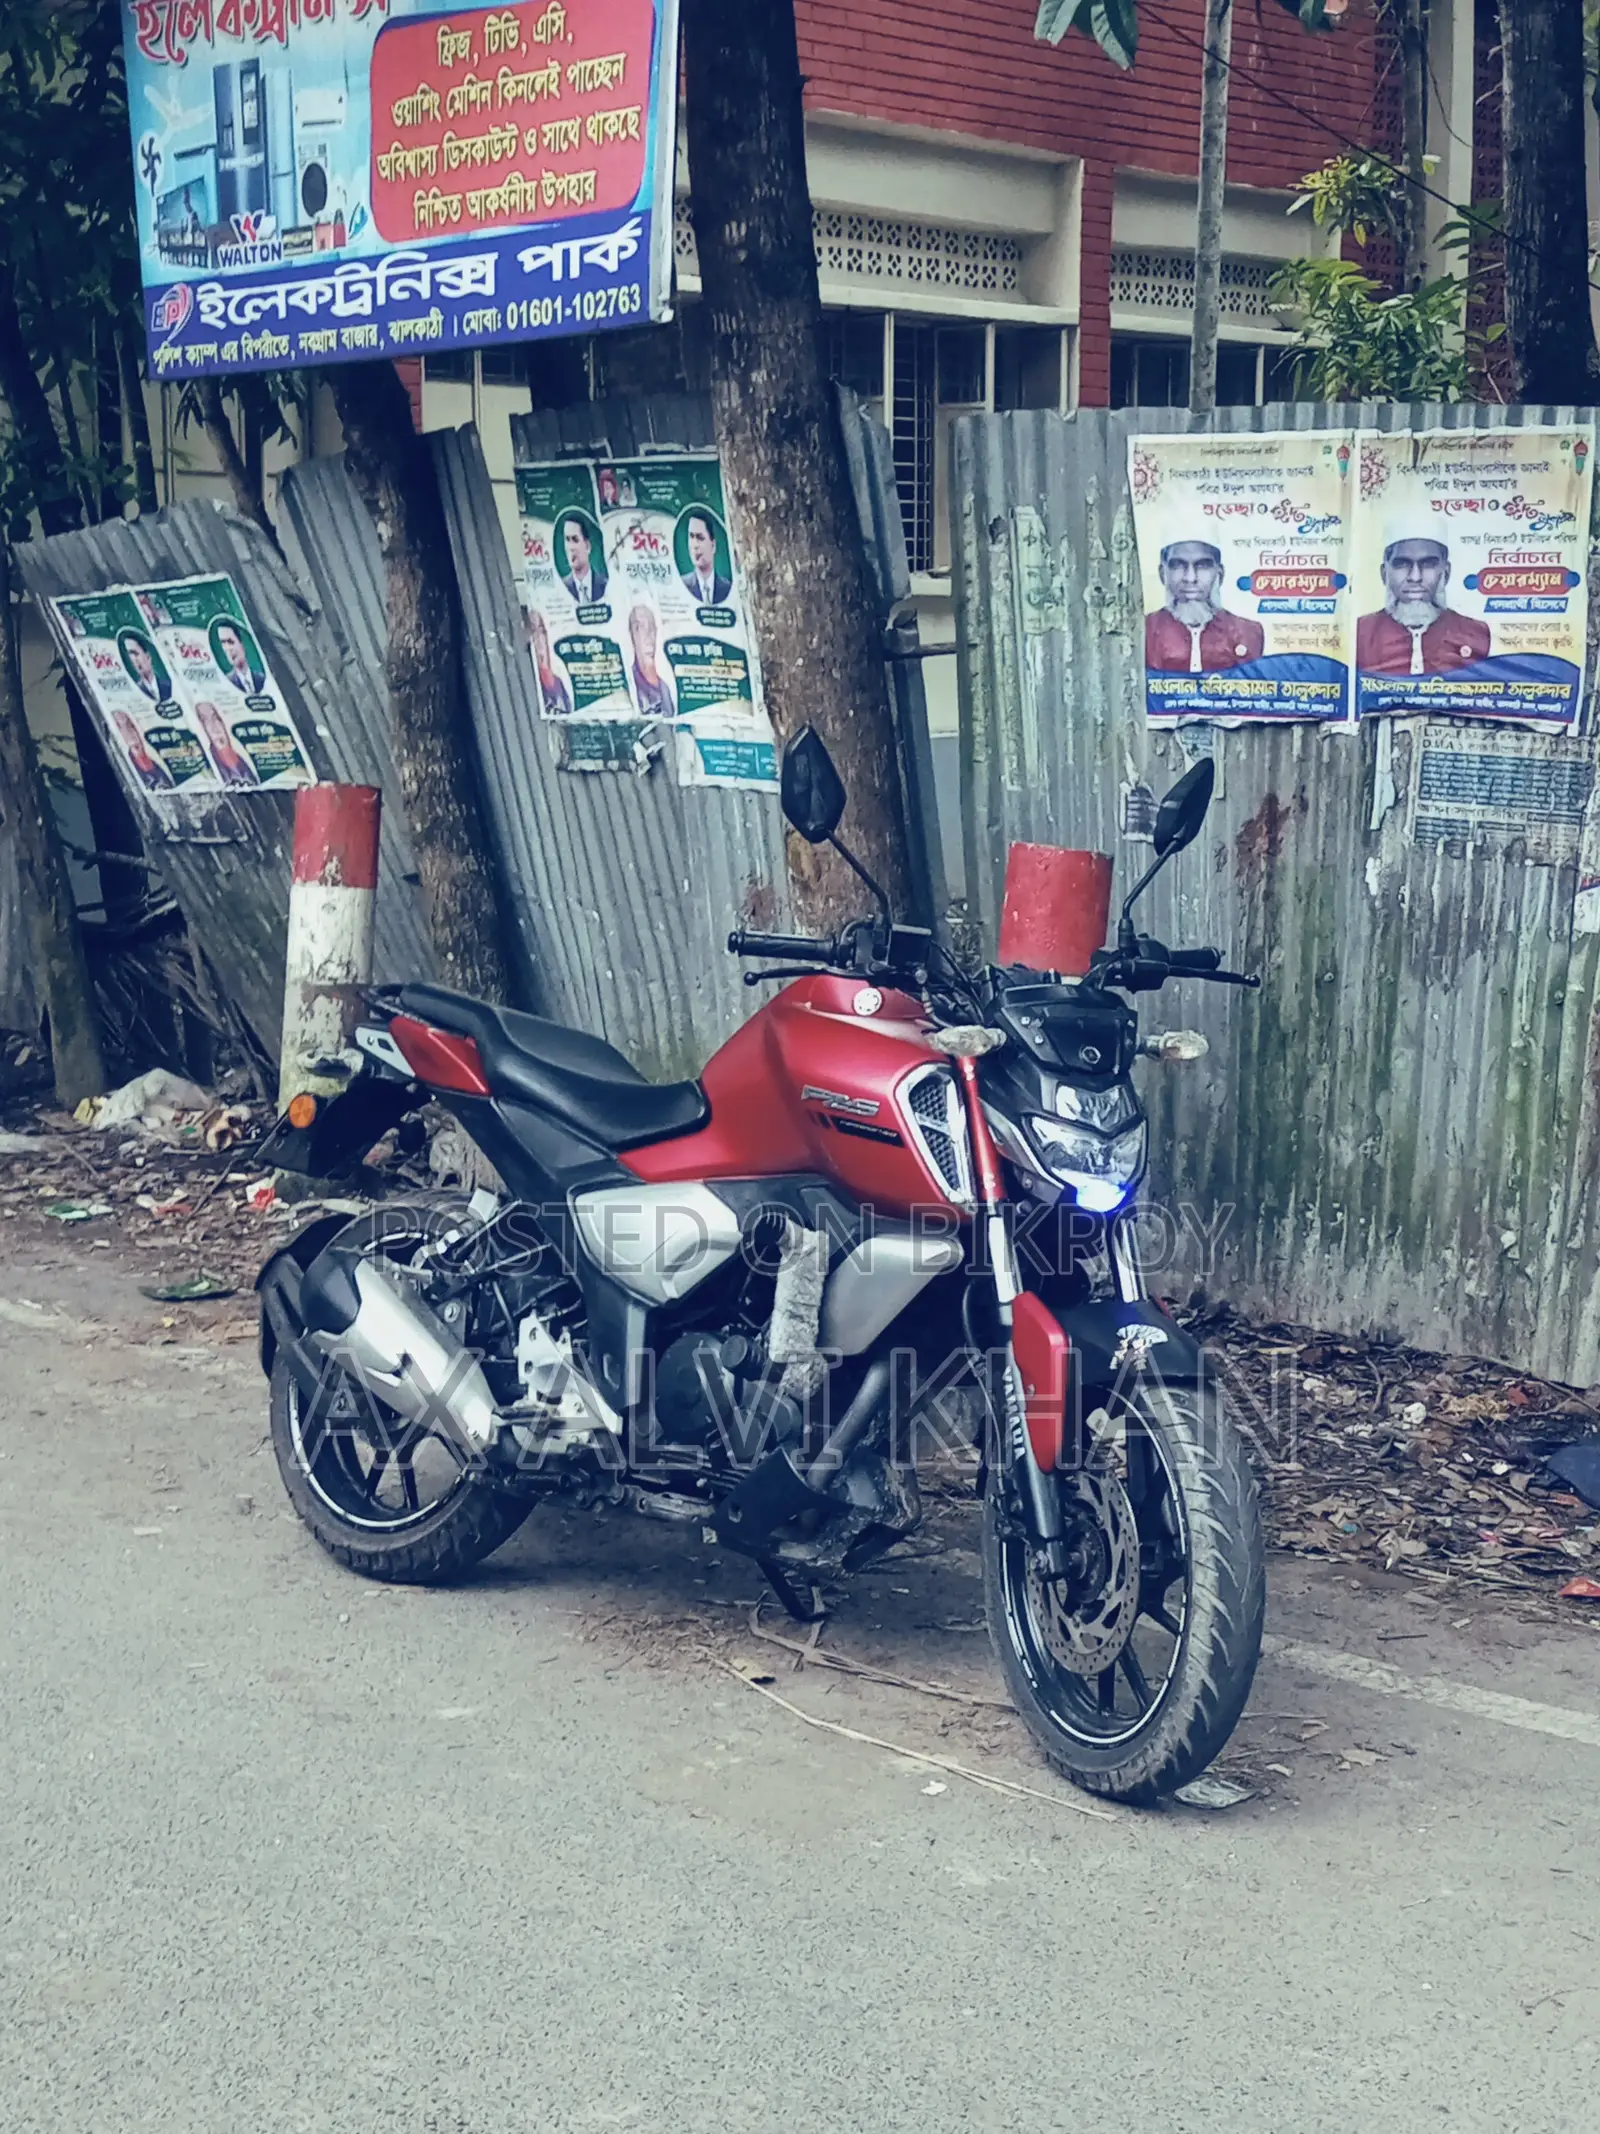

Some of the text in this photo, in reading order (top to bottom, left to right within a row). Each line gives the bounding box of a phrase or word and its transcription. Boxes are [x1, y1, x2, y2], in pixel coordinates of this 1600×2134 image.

[446, 73, 493, 118] মেশিন
[497, 61, 561, 109] কিনলেই
[566, 52, 627, 94] পাচ্ছেন
[443, 123, 519, 173] ডিসকাউন্ট
[523, 129, 538, 156] ও
[542, 117, 582, 153] সাথে
[586, 105, 641, 146] থাকছে
[414, 187, 463, 230] নিশ্চিত
[540, 169, 597, 207] উপহার
[196, 217, 642, 329] ইলেকট্রনিক্স পার্ক
[220, 241, 283, 268] WALTON
[221, 340, 240, 363] এর
[506, 283, 642, 331] 01601-102763
[1259, 549, 1328, 566] নির্বাচনে
[1488, 547, 1562, 565] নির্বাচনে
[1148, 679, 1197, 695] মাওলানা
[1281, 682, 1342, 702] তালুকদার
[1360, 676, 1417, 694] মাওলানা
[1508, 682, 1572, 701] তালুকদার
